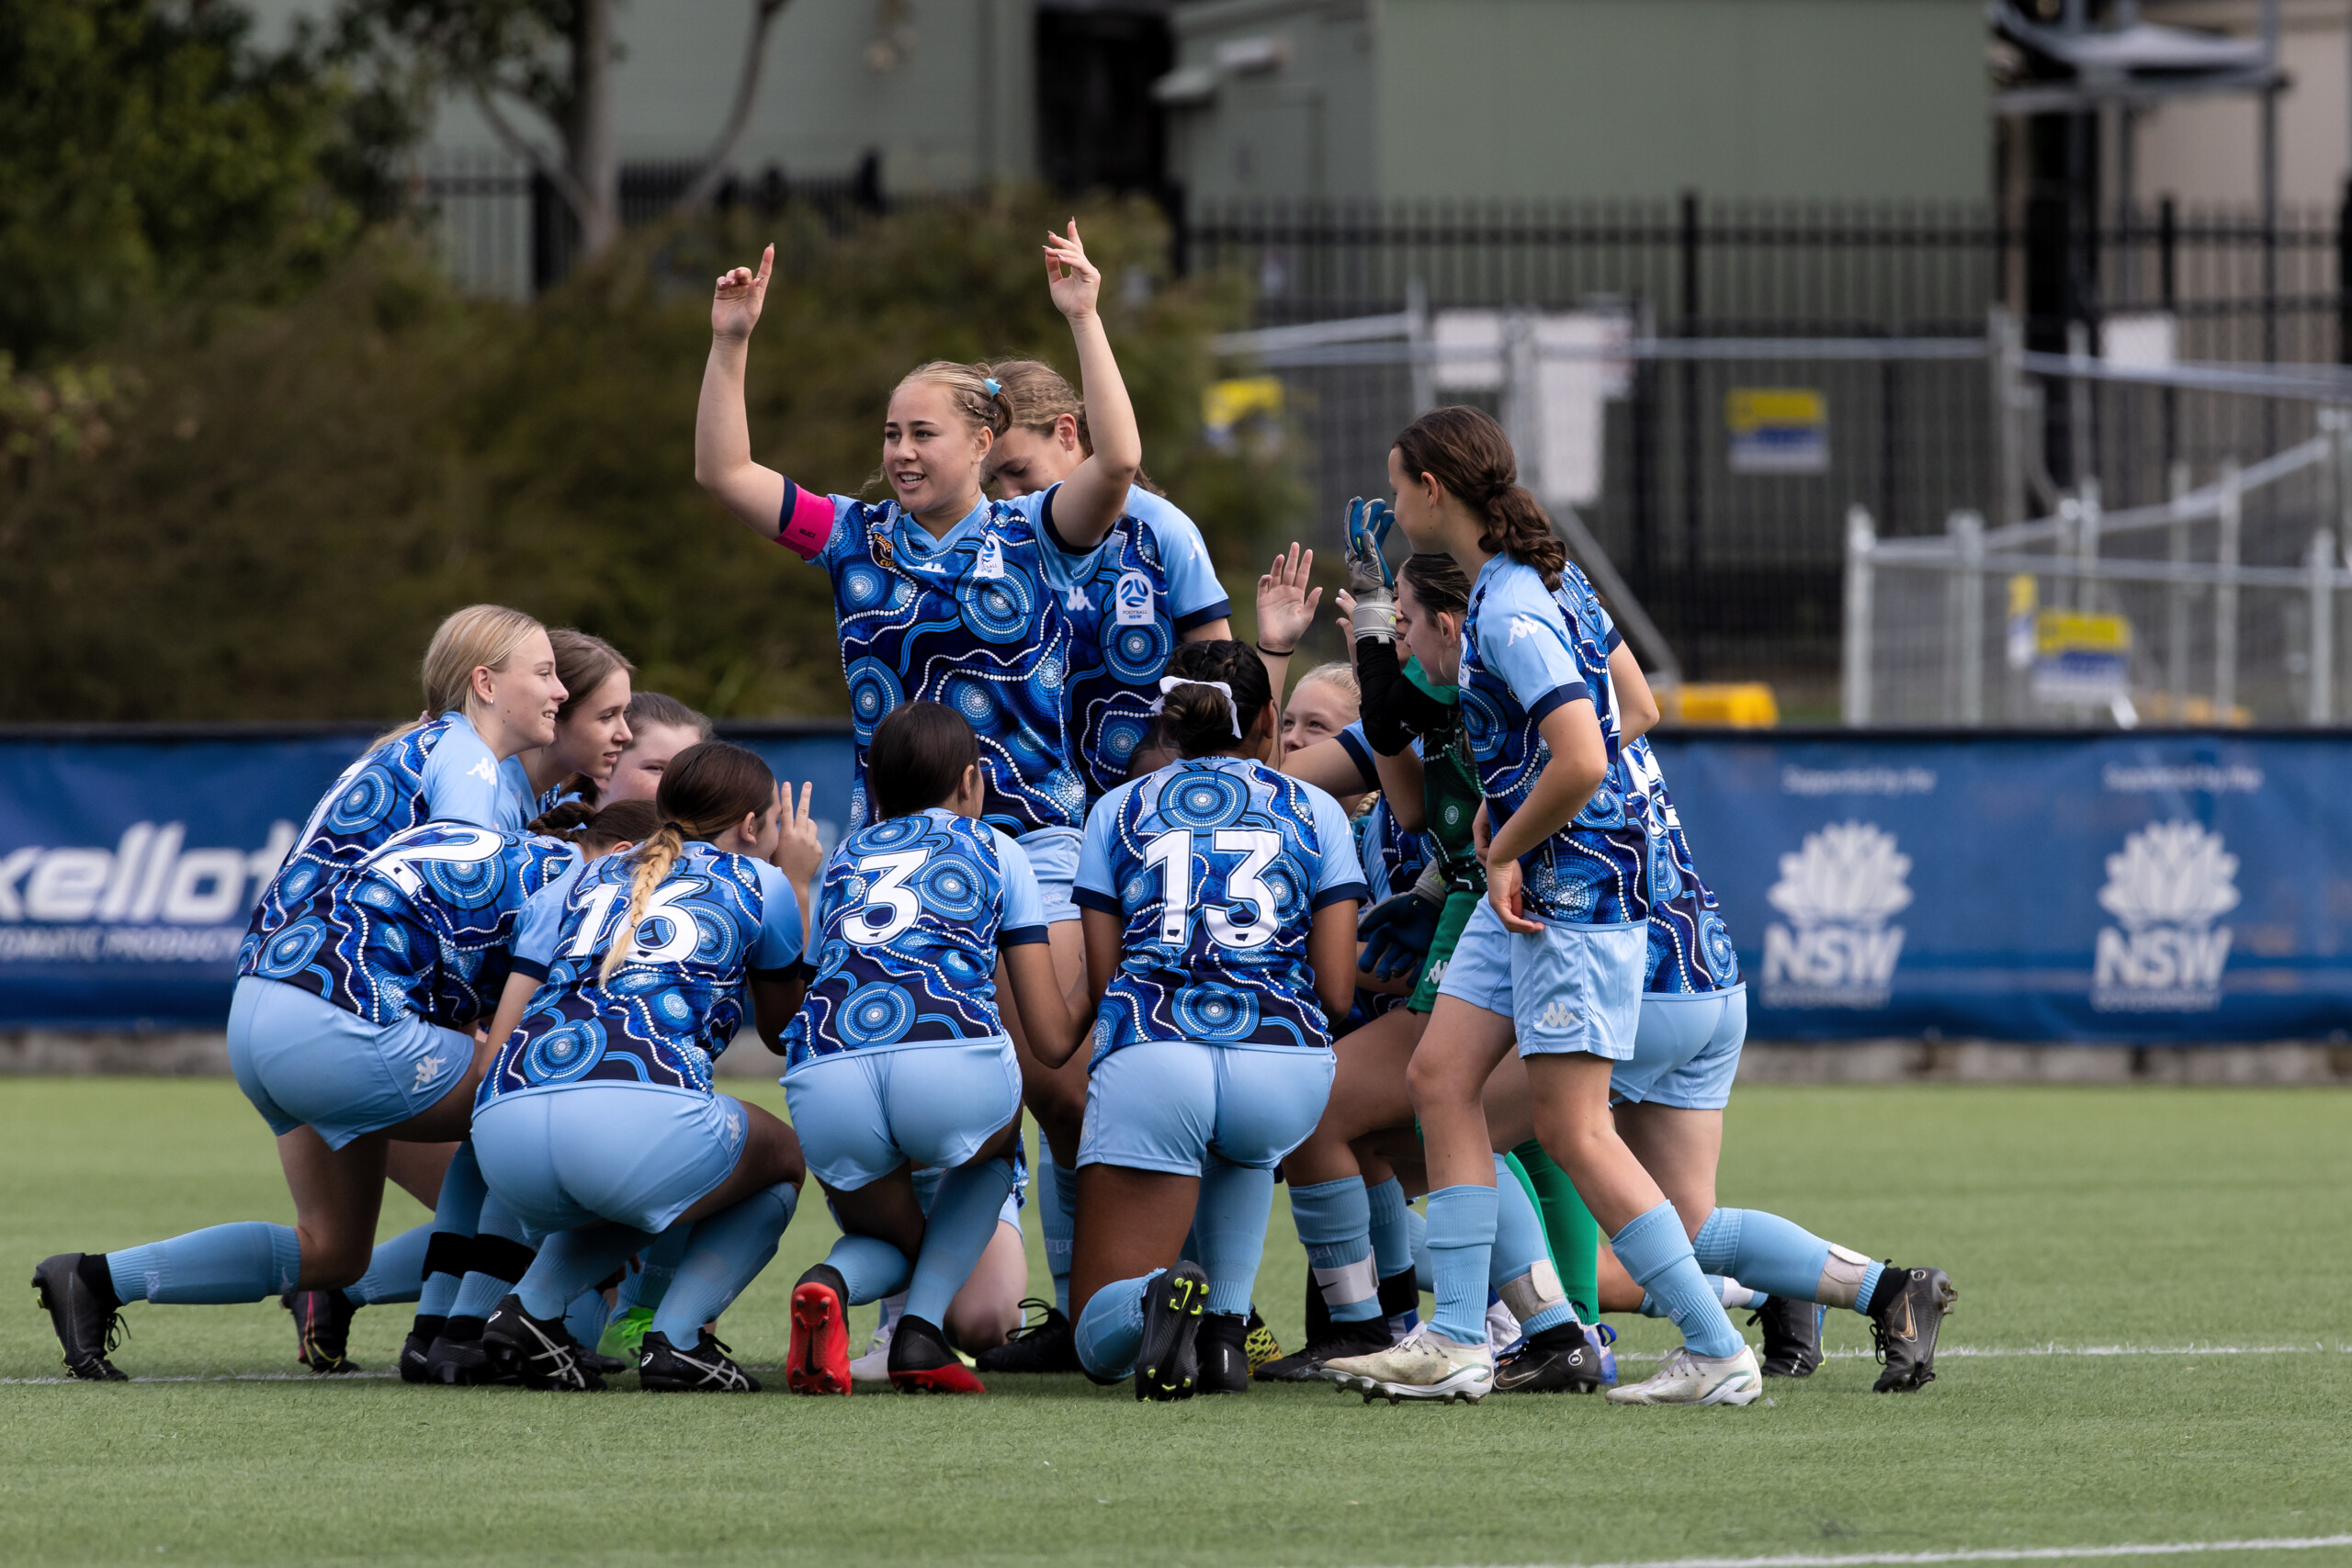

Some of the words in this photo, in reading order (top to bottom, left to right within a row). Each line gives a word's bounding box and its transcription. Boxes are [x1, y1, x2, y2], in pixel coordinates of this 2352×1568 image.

[570, 879, 703, 962] 16
[841, 847, 933, 945] 3
[1144, 828, 1283, 949] 13
[1764, 922, 1905, 985] NSW
[2096, 925, 2233, 987] NSW
